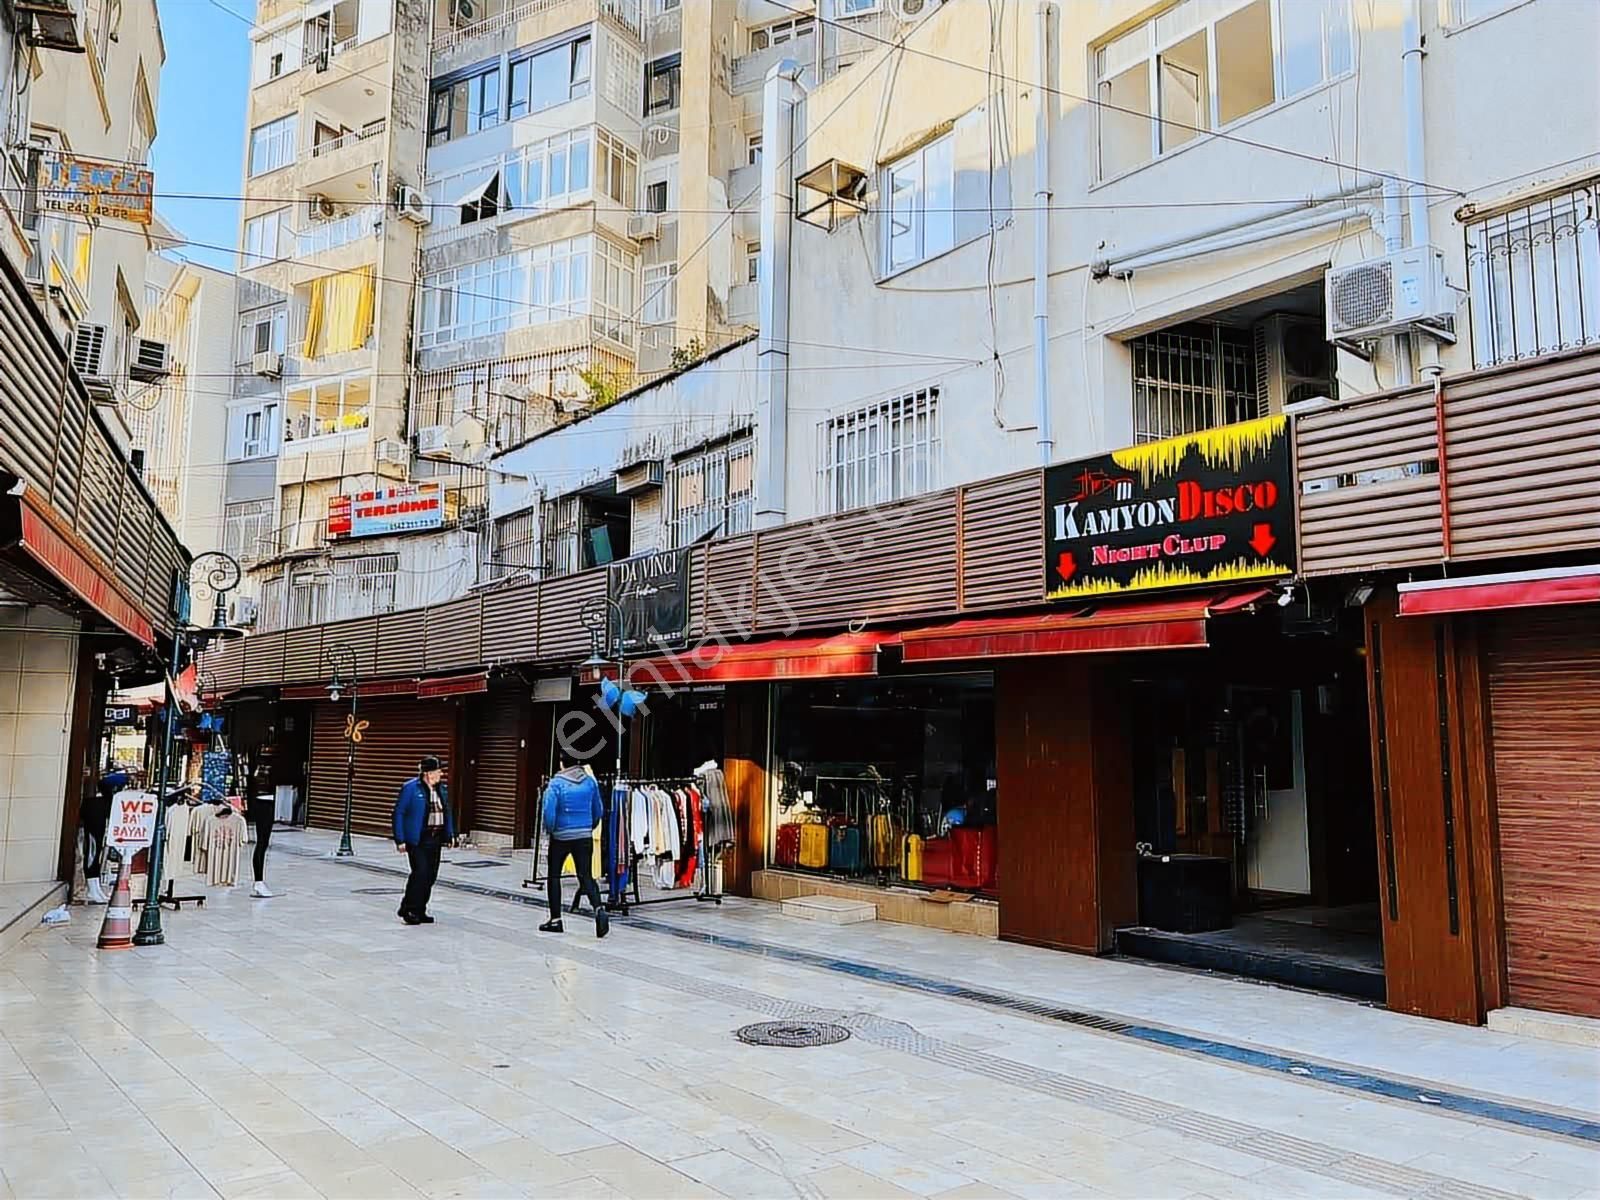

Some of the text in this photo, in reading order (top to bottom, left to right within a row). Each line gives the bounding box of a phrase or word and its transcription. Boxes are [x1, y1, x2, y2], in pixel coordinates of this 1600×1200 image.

[1054, 480, 1278, 541] KAMYON DISCO
[1091, 533, 1227, 566] NIGHT CLUP
[620, 551, 676, 583] DA VINCI
[121, 800, 153, 814] WC
